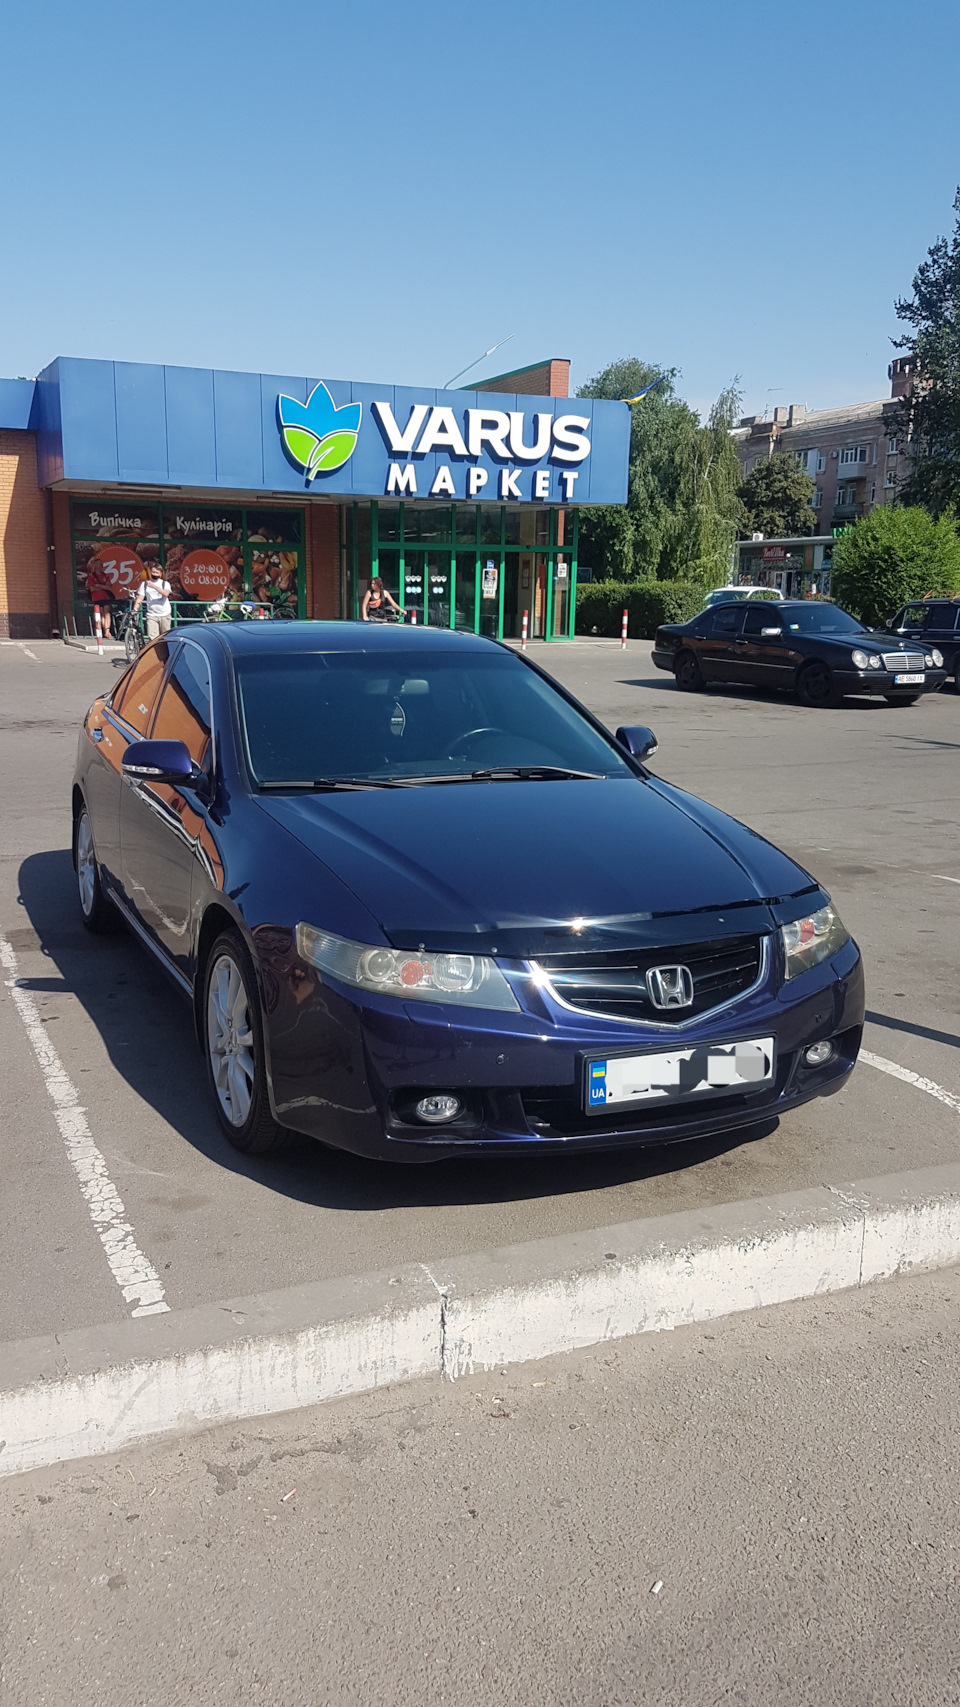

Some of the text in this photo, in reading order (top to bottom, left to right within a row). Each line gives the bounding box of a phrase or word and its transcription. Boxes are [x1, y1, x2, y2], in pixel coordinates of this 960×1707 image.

[373, 401, 592, 462] VARUS
[386, 462, 579, 498] МАРКЕТ
[89, 511, 142, 528] Випічка
[176, 516, 233, 537] Кулінарія
[193, 564, 223, 574] 20:00
[184, 575, 227, 585] до 08:00
[591, 1088, 605, 1099] UA
